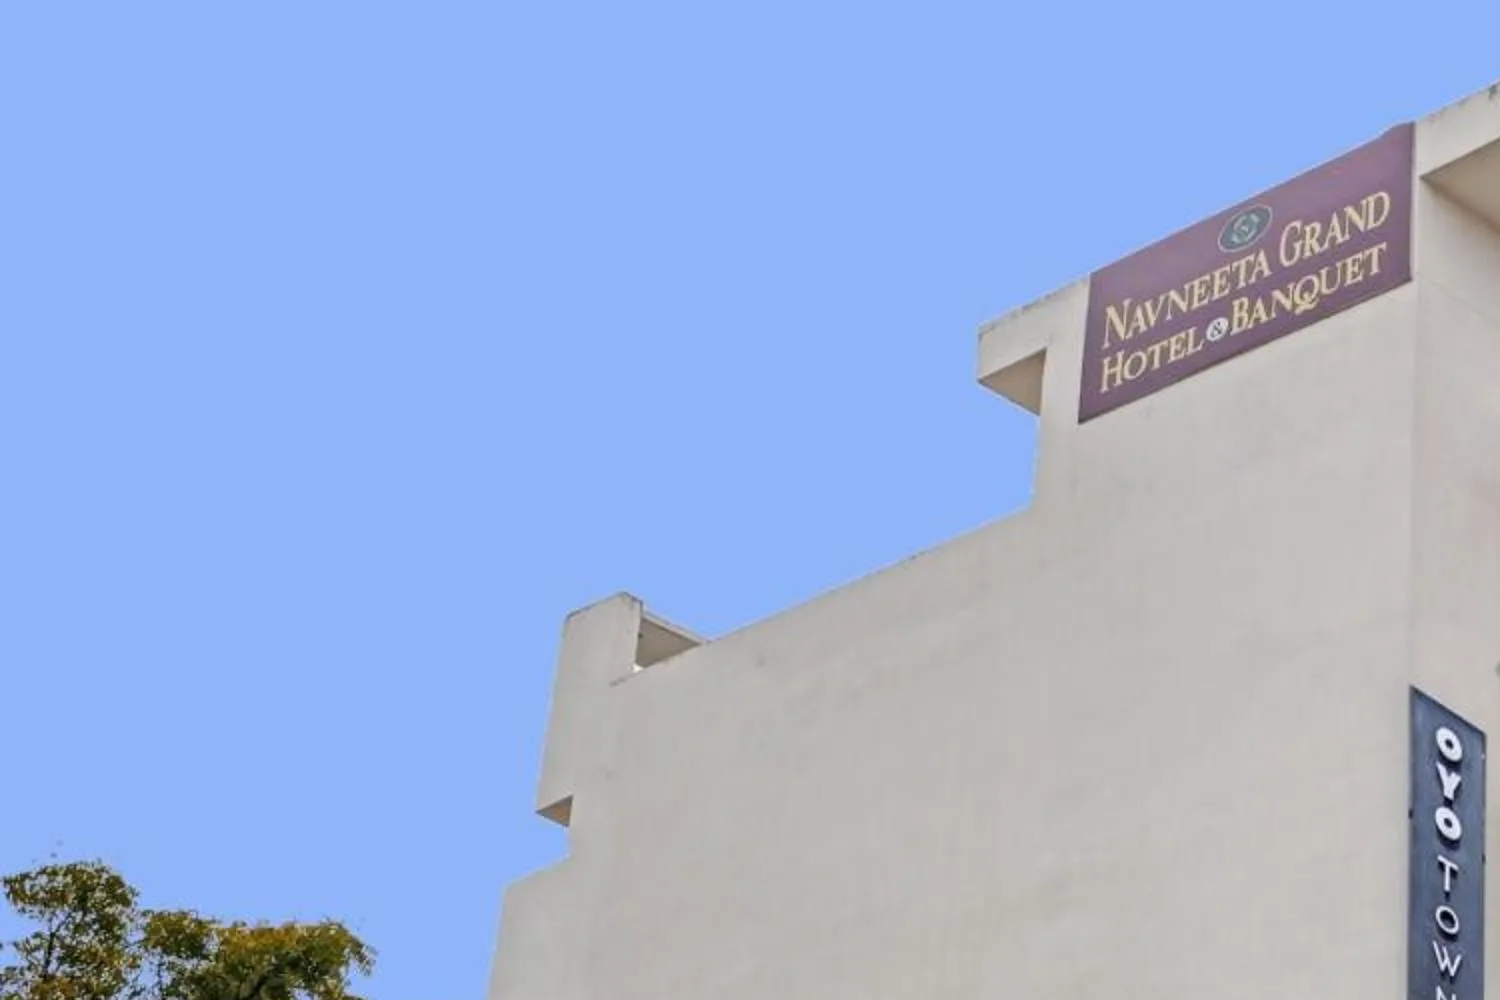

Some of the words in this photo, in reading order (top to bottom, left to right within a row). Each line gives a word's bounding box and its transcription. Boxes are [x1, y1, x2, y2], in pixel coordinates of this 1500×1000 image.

[1100, 327, 1205, 393] HOTEL
[1229, 242, 1388, 336] BANQUET
[1103, 249, 1273, 349] NAVNEETA
[1279, 191, 1390, 267] GRAND
[1435, 727, 1463, 841] OYO
